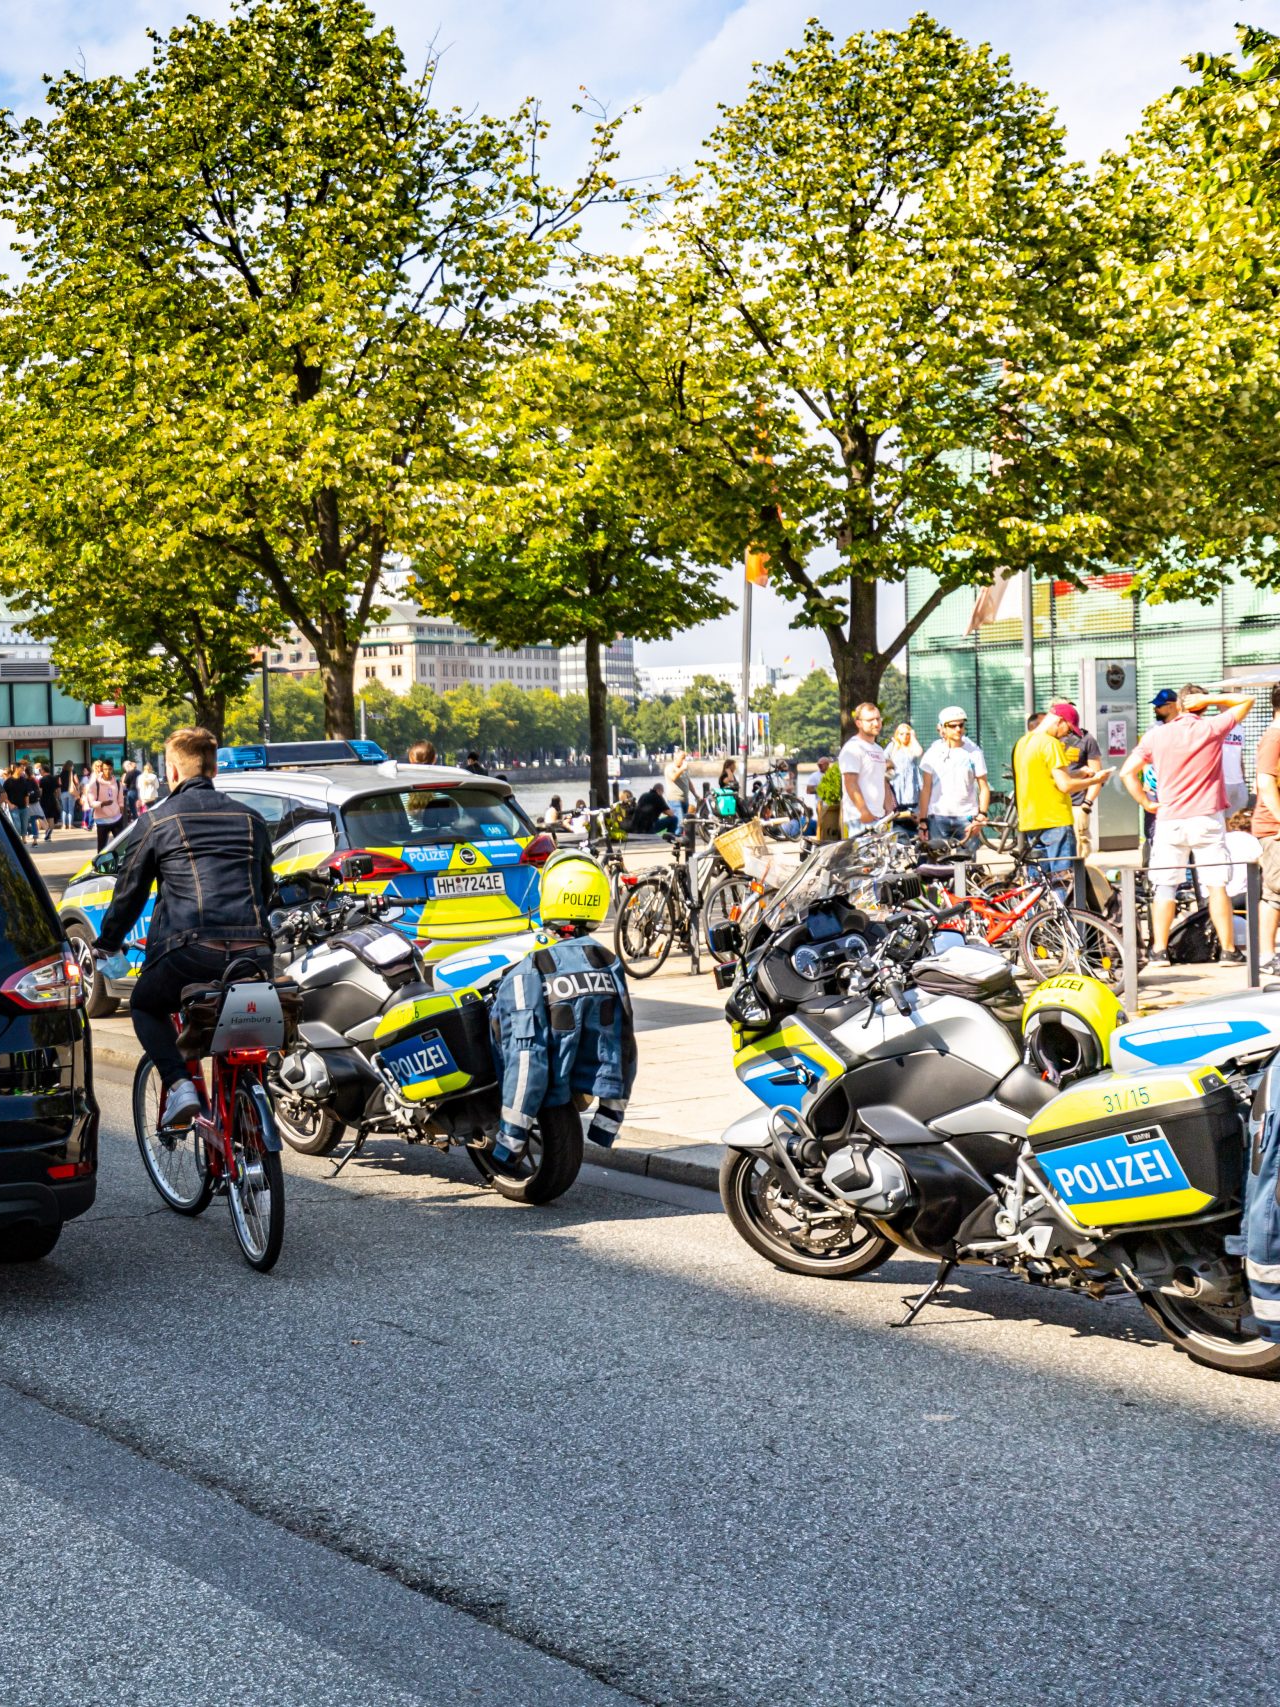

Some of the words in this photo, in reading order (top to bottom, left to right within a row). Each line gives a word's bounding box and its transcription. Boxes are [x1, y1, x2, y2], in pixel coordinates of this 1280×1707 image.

[409, 850, 450, 862] POLIZEI
[437, 878, 456, 893] HH
[462, 875, 502, 892] 7241E
[563, 893, 601, 907] POLIZEI
[542, 972, 617, 999] POLIZEI
[231, 1016, 271, 1024] Hamburg
[389, 1045, 448, 1082] POLIZEI
[1055, 1149, 1173, 1197] POLIZEI
